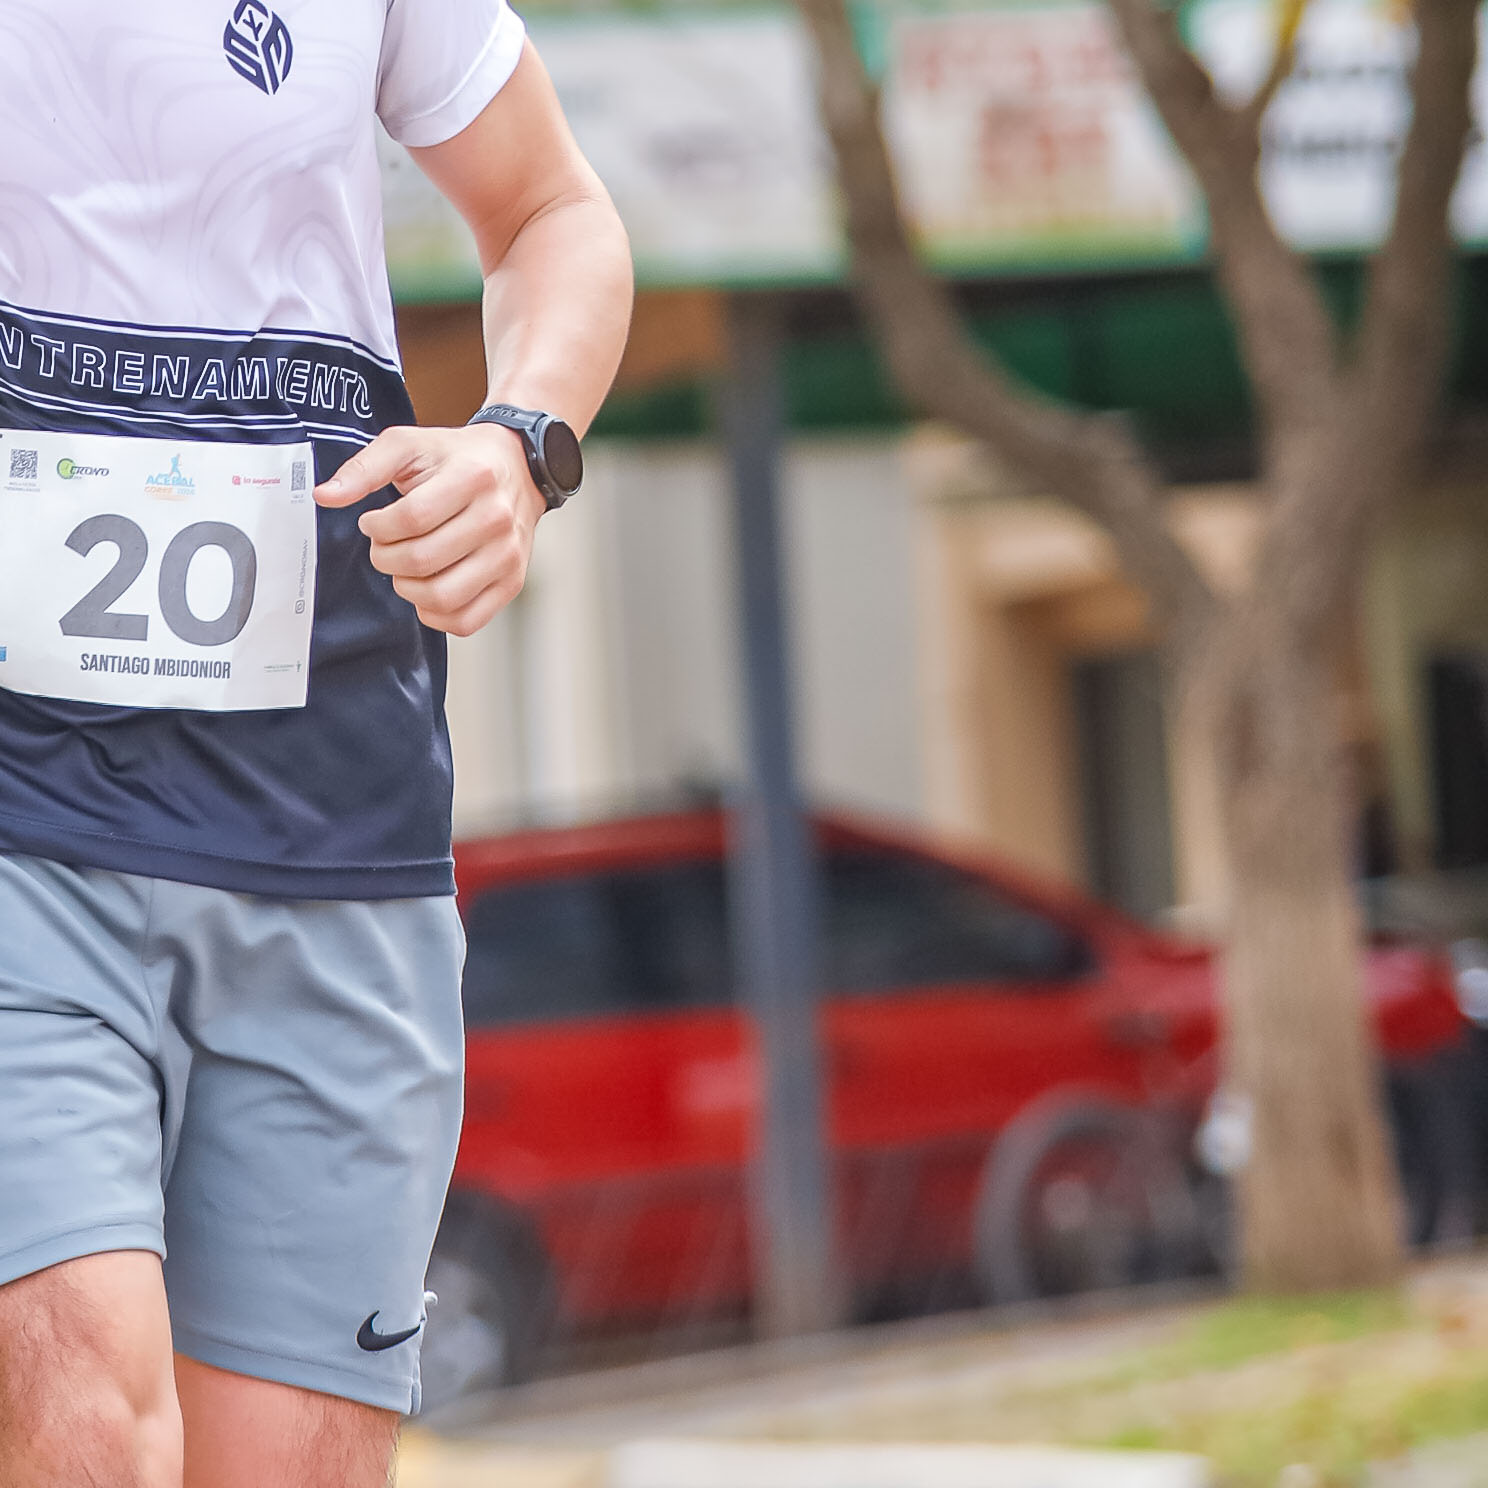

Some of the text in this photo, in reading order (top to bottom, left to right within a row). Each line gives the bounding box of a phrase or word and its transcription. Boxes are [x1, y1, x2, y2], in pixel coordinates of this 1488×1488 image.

[58, 513, 257, 647] 20
[80, 653, 231, 679] SANTIAGO MBIDONIOR
